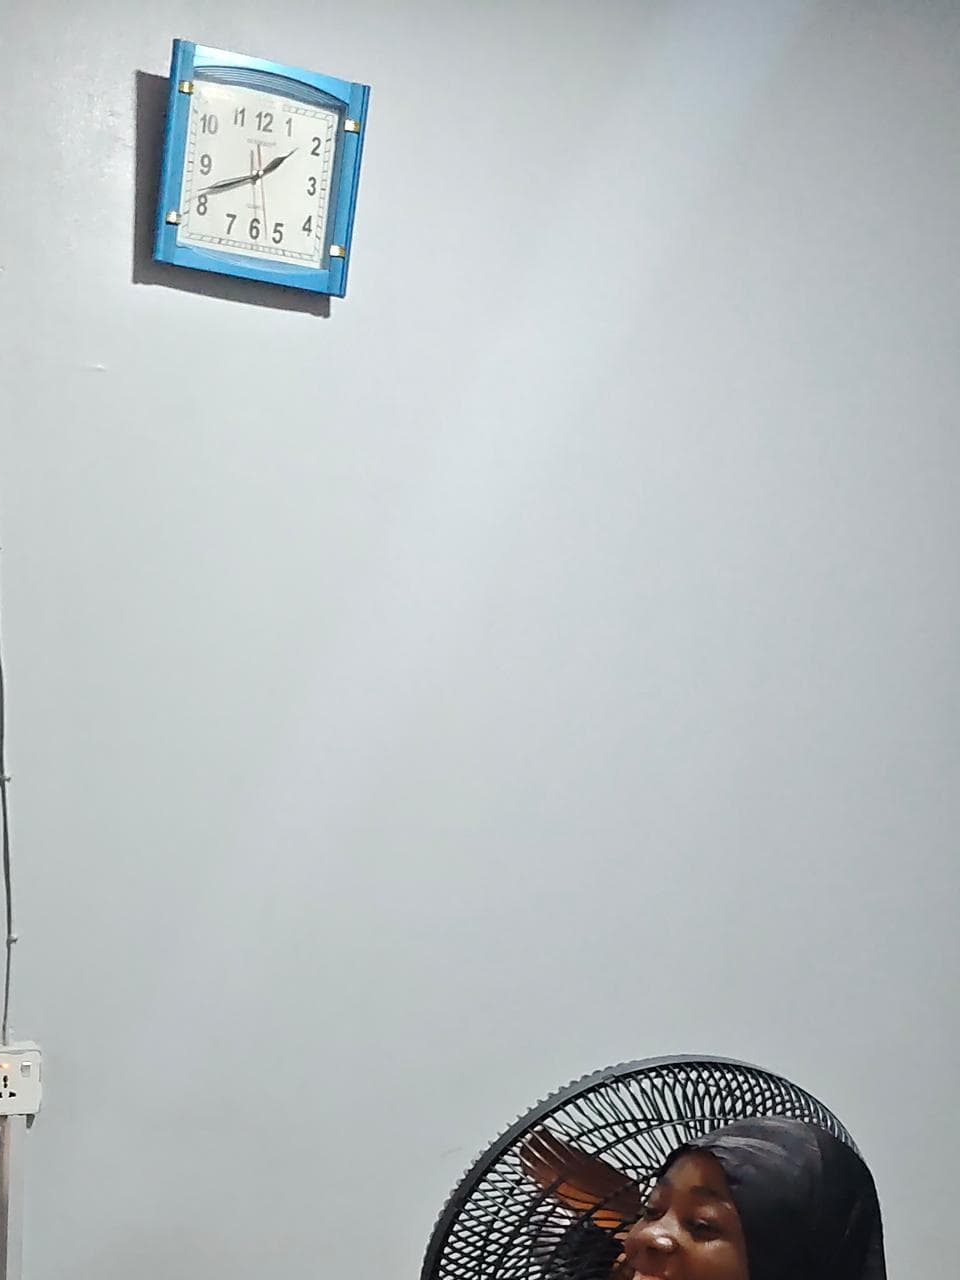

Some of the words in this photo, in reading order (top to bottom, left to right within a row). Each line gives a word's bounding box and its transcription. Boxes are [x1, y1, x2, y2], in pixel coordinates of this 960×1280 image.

[199, 113, 219, 134] 10
[234, 107, 246, 127] 11
[255, 111, 273, 133] 12
[285, 118, 293, 137] 1
[311, 136, 321, 157] 2
[200, 154, 212, 176] 9
[306, 177, 317, 196] 3
[196, 194, 208, 216] 8
[225, 213, 237, 235] 7
[249, 218, 260, 240] 6
[272, 223, 284, 244] 5
[302, 216, 313, 236] 4
